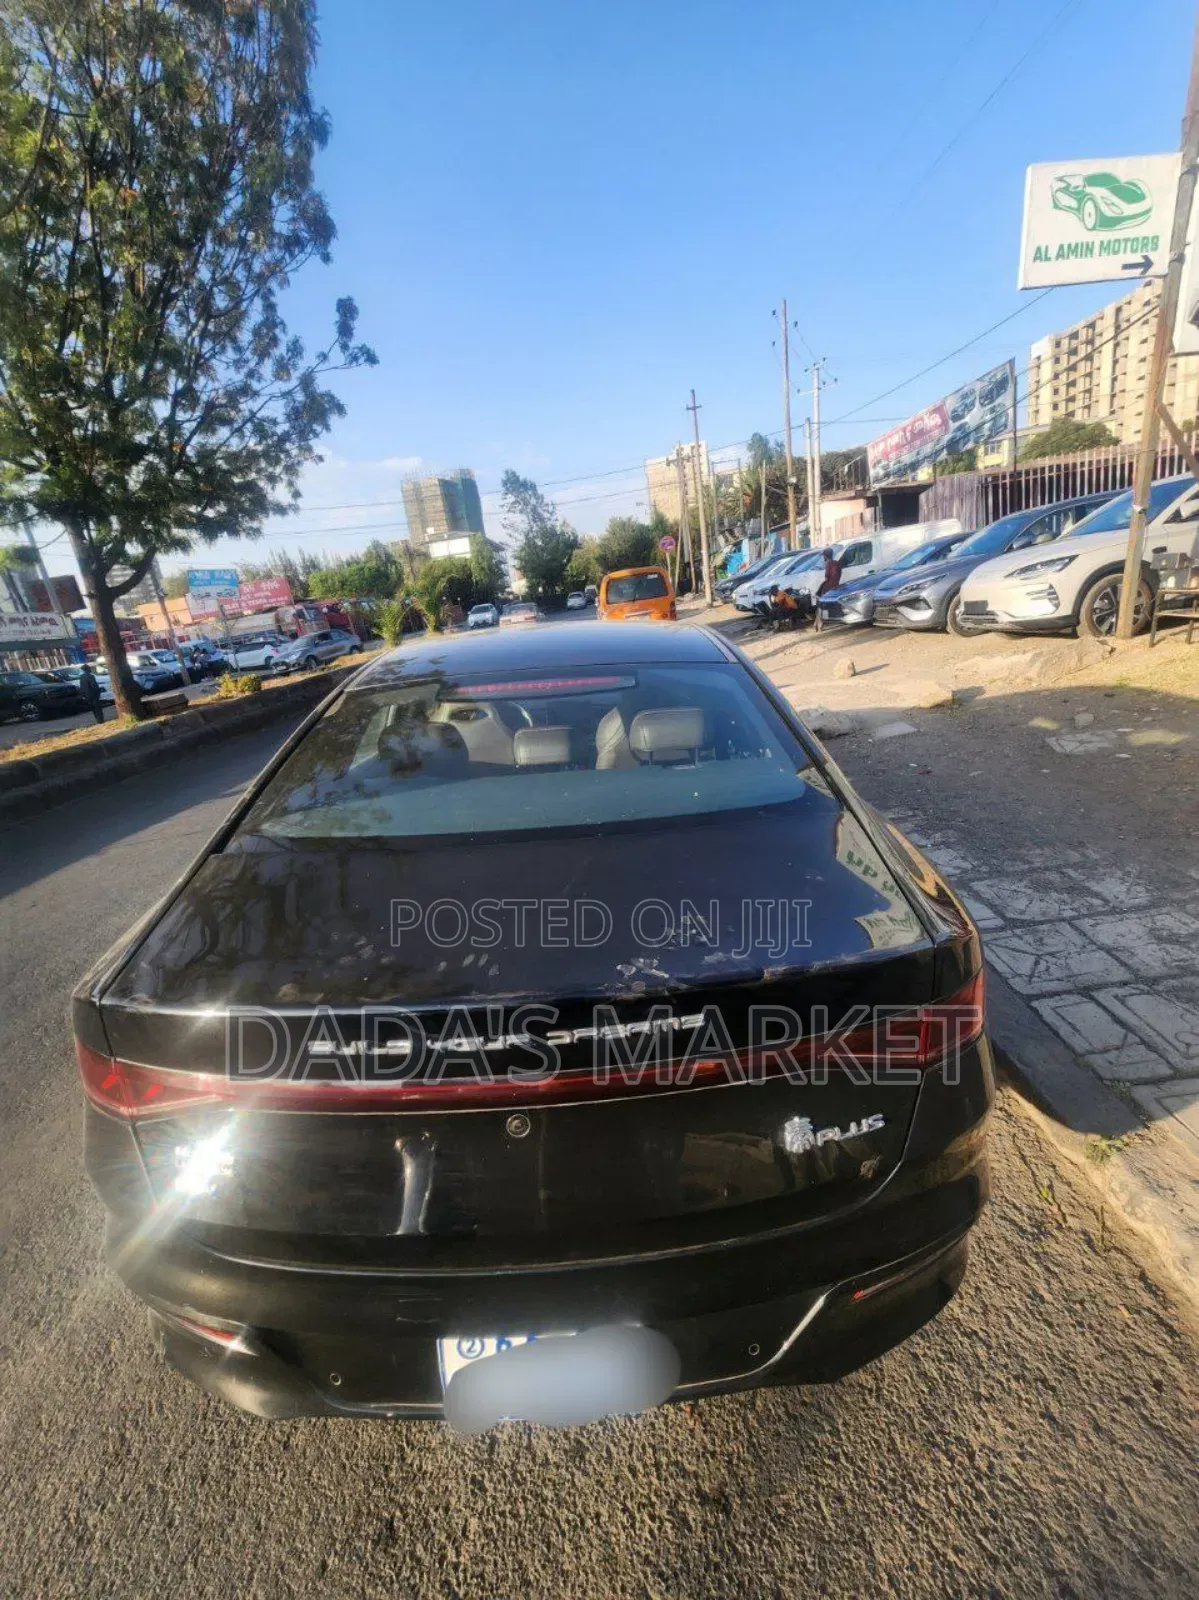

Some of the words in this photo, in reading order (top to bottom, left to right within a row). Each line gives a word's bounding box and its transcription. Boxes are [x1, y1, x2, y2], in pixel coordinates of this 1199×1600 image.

[1033, 243, 1052, 263] AL
[1055, 239, 1096, 261] AMIN
[1098, 234, 1161, 257] MOTORS
[815, 1113, 886, 1147] PLUS
